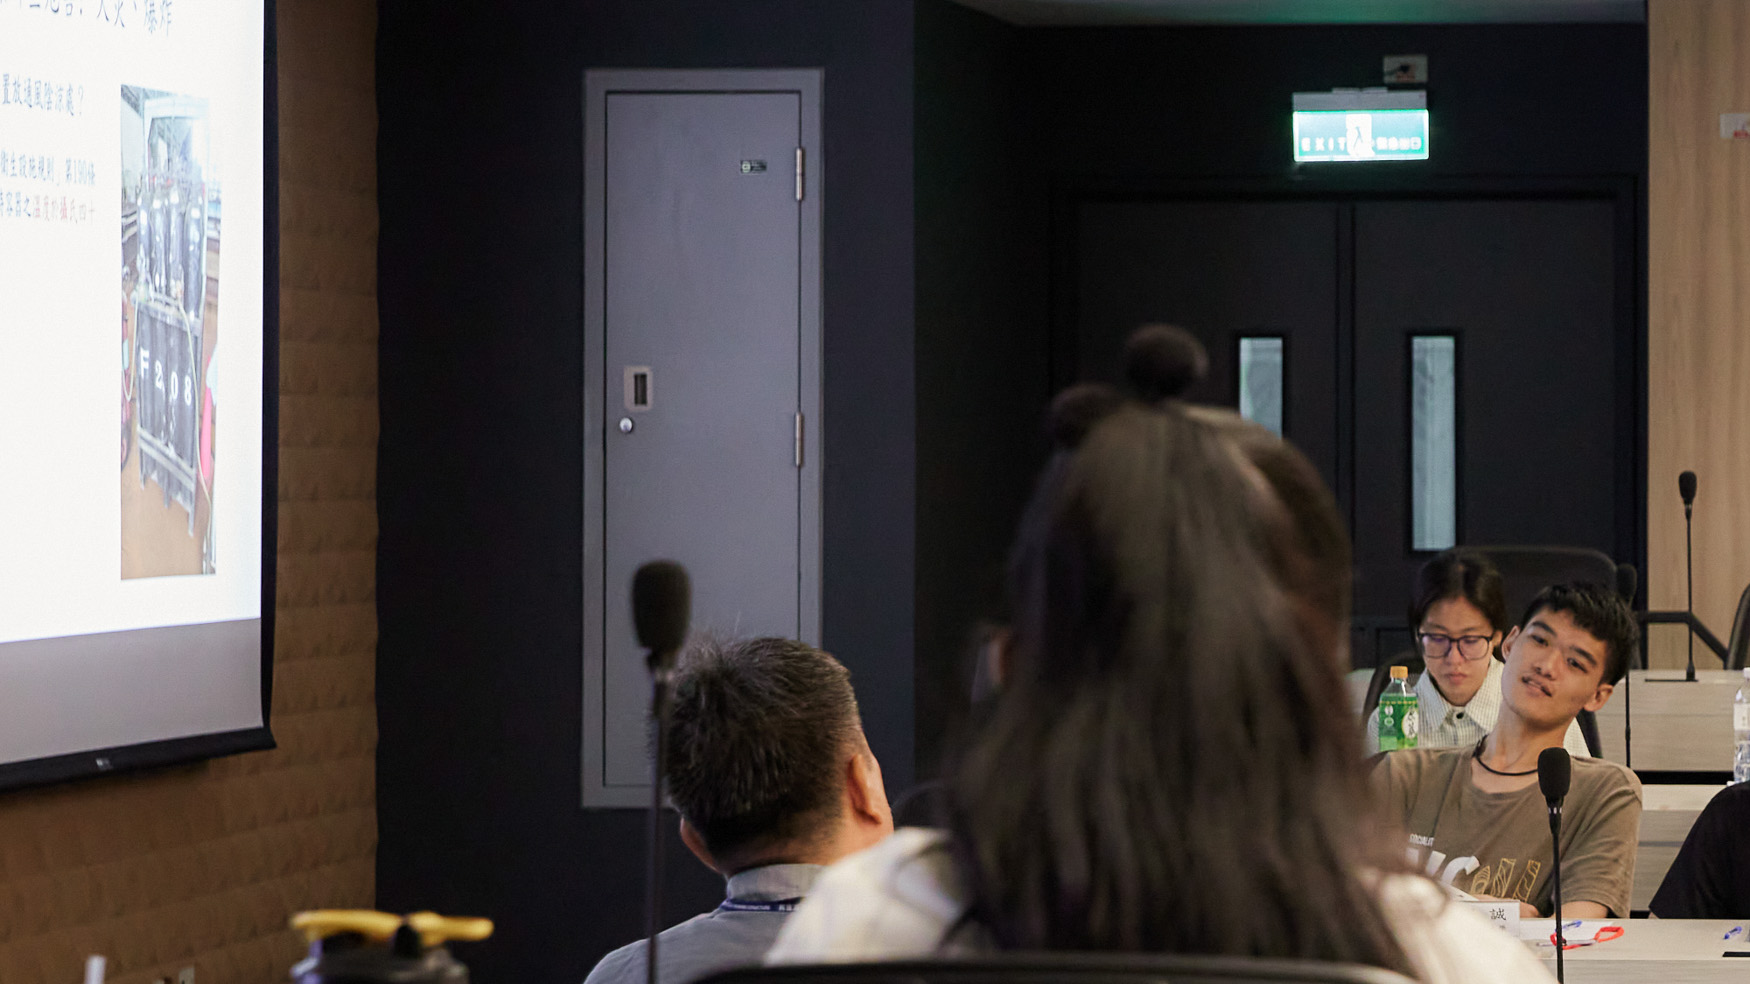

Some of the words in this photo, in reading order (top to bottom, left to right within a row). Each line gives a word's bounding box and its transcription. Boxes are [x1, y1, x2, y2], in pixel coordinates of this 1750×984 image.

[1301, 137, 1347, 152] EXIT
[140, 346, 192, 406] F208
[1489, 908, 1506, 921] 誠
